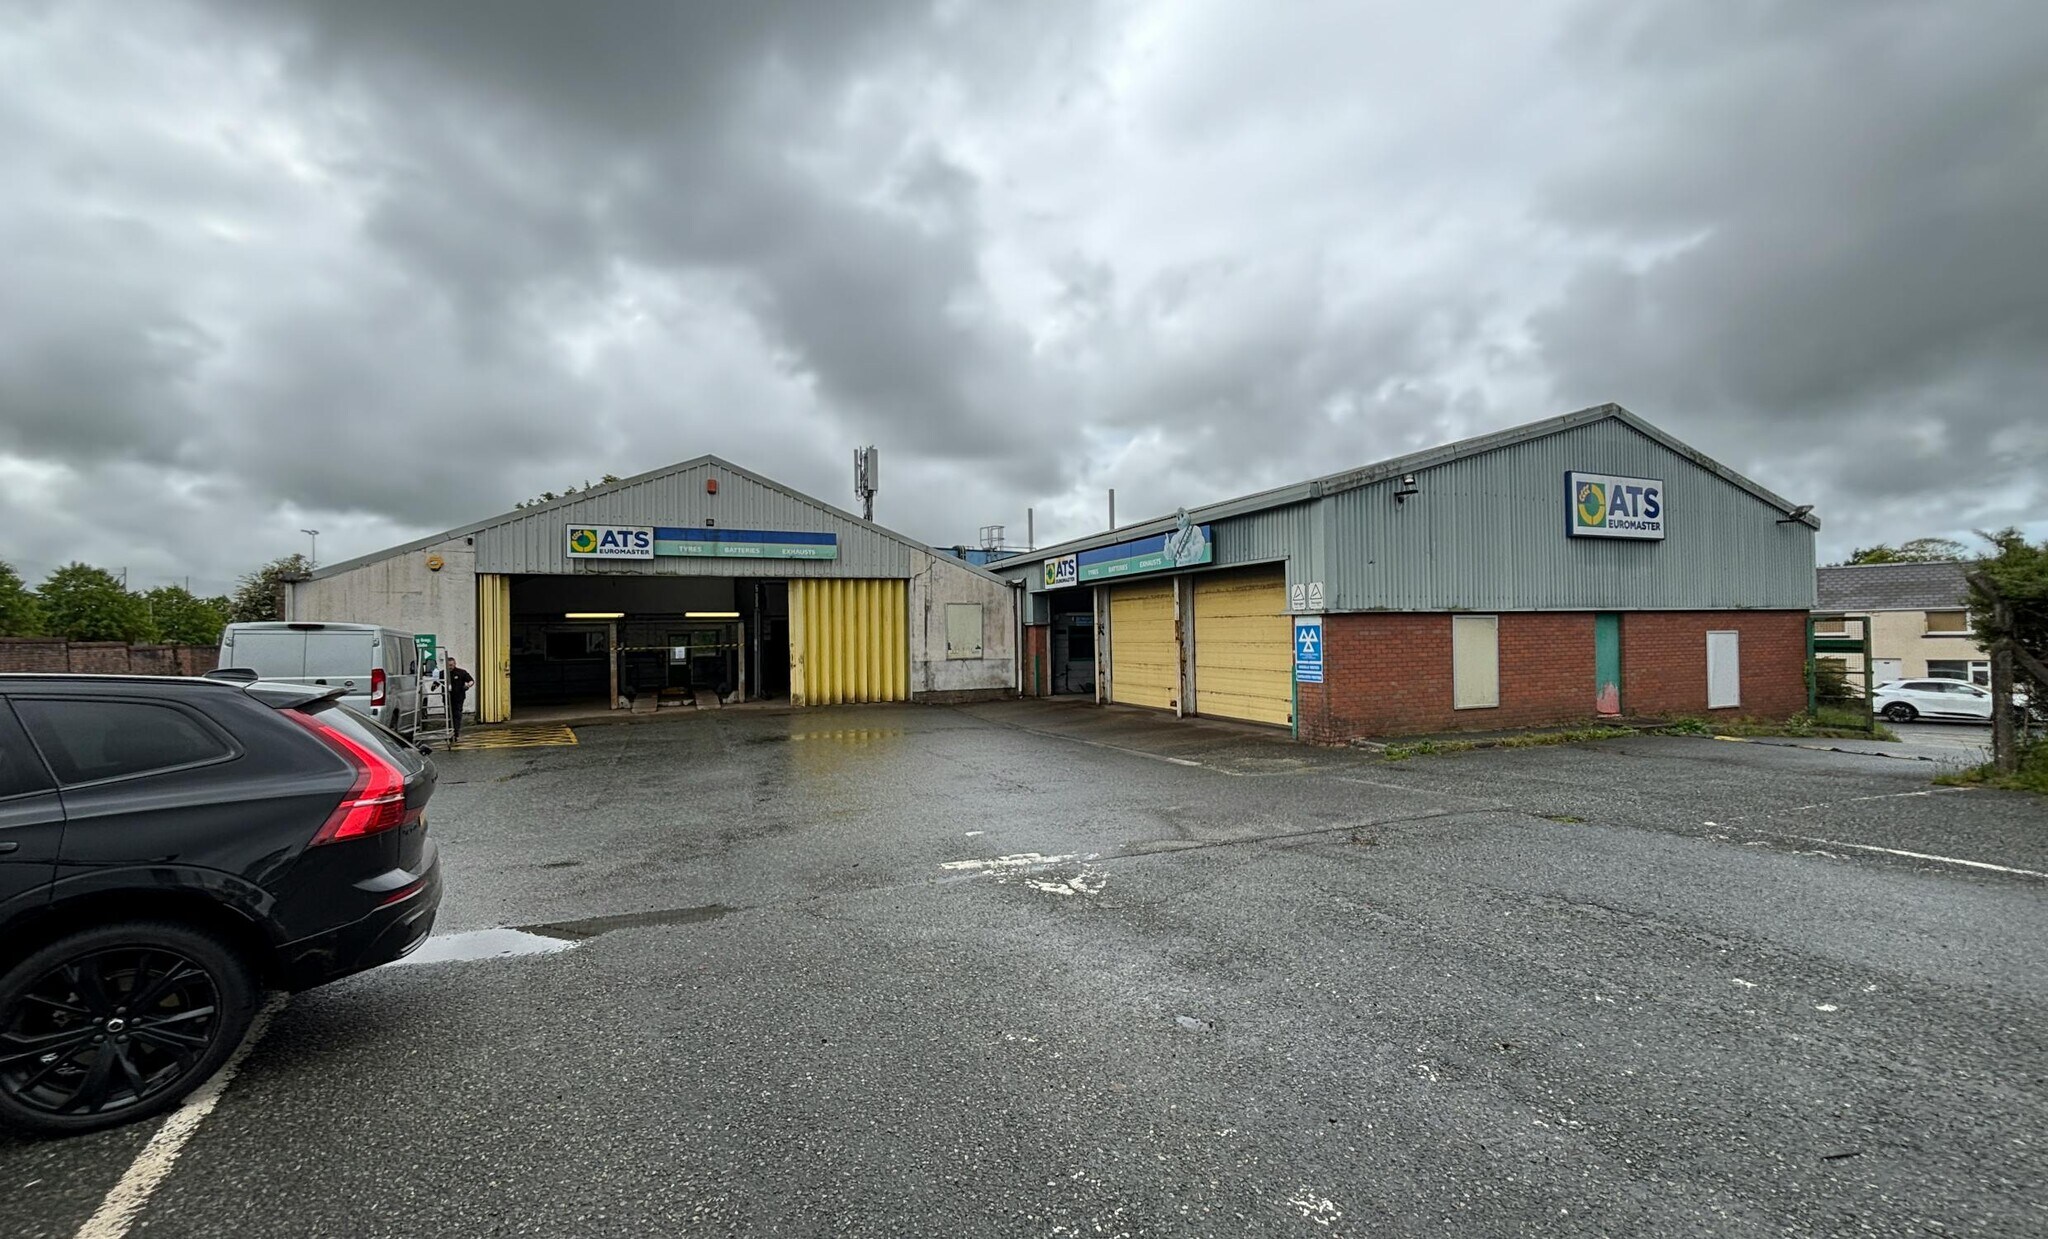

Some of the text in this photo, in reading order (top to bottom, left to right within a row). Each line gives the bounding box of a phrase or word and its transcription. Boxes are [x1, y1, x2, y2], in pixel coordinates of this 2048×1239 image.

[1608, 484, 1660, 519] ATS
[1608, 519, 1661, 531] EUROMASTER
[600, 529, 650, 548] ATS
[679, 545, 702, 553] TYRES
[782, 548, 816, 556] EXHAUSTS
[1056, 559, 1075, 577] ATS
